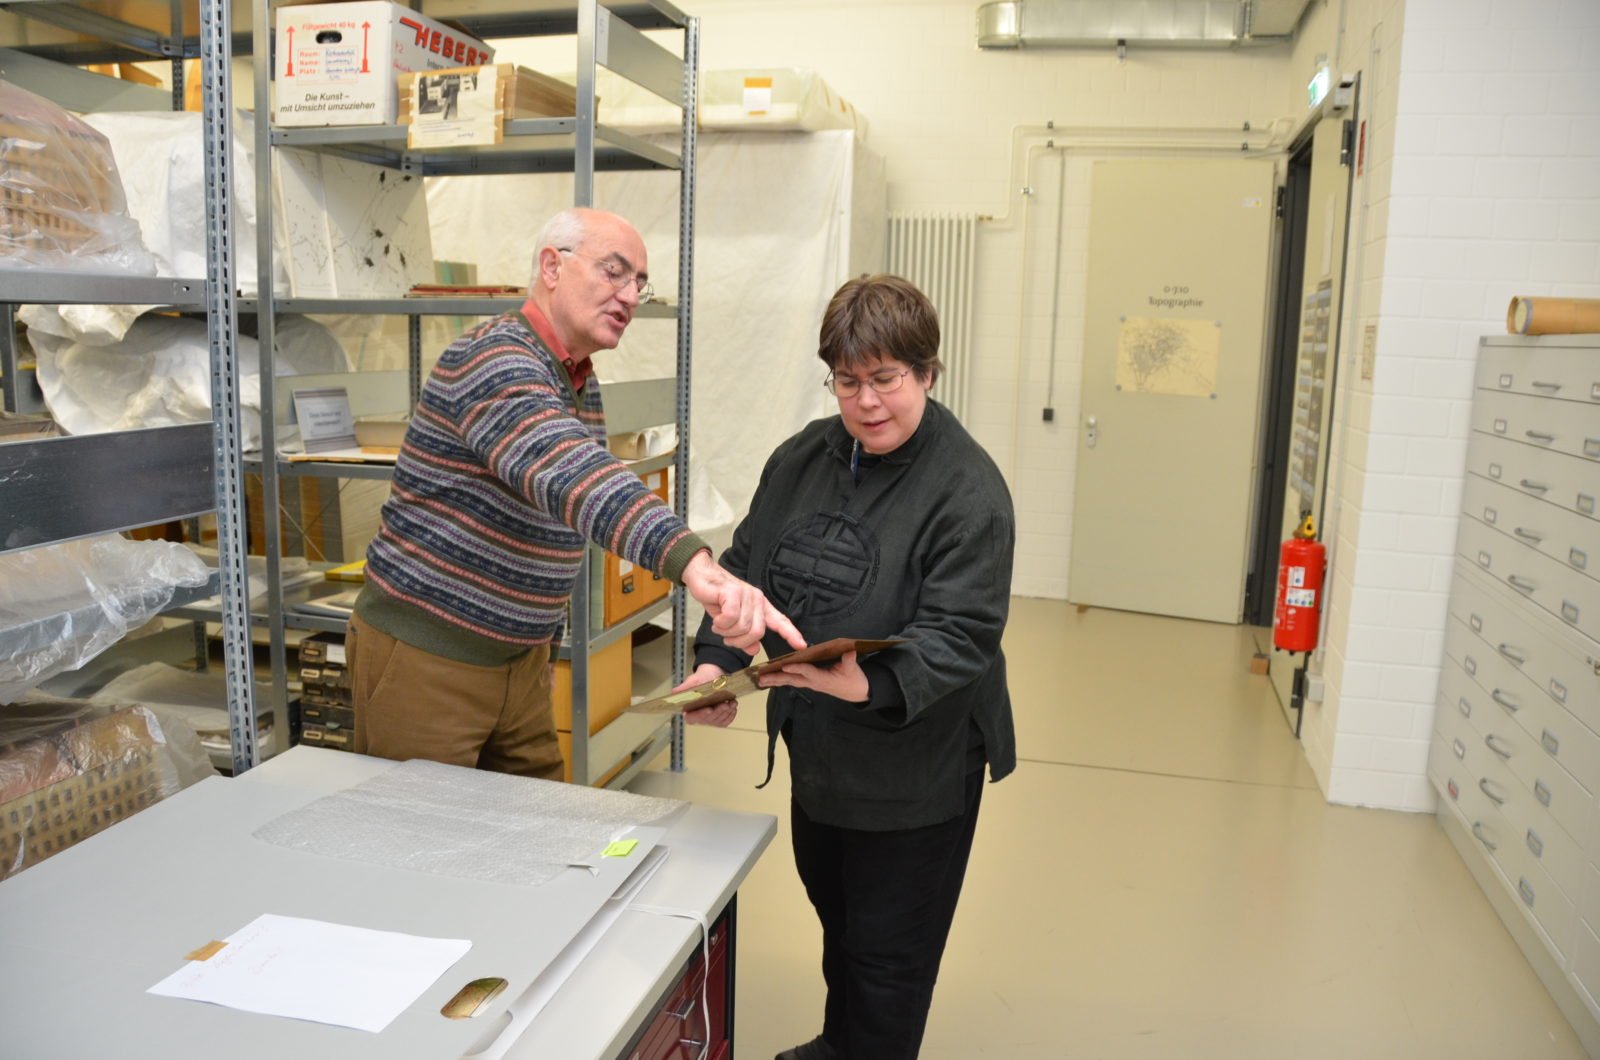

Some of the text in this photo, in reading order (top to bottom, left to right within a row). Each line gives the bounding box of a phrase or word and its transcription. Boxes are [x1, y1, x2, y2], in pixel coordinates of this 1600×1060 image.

[347, 21, 356, 29] kg
[400, 16, 489, 66] HEBERT
[305, 93, 318, 102] Die
[320, 92, 343, 101] Kunst
[280, 101, 376, 113] mit Umsicht umzuziehen
[1148, 295, 1204, 309] Topographie
